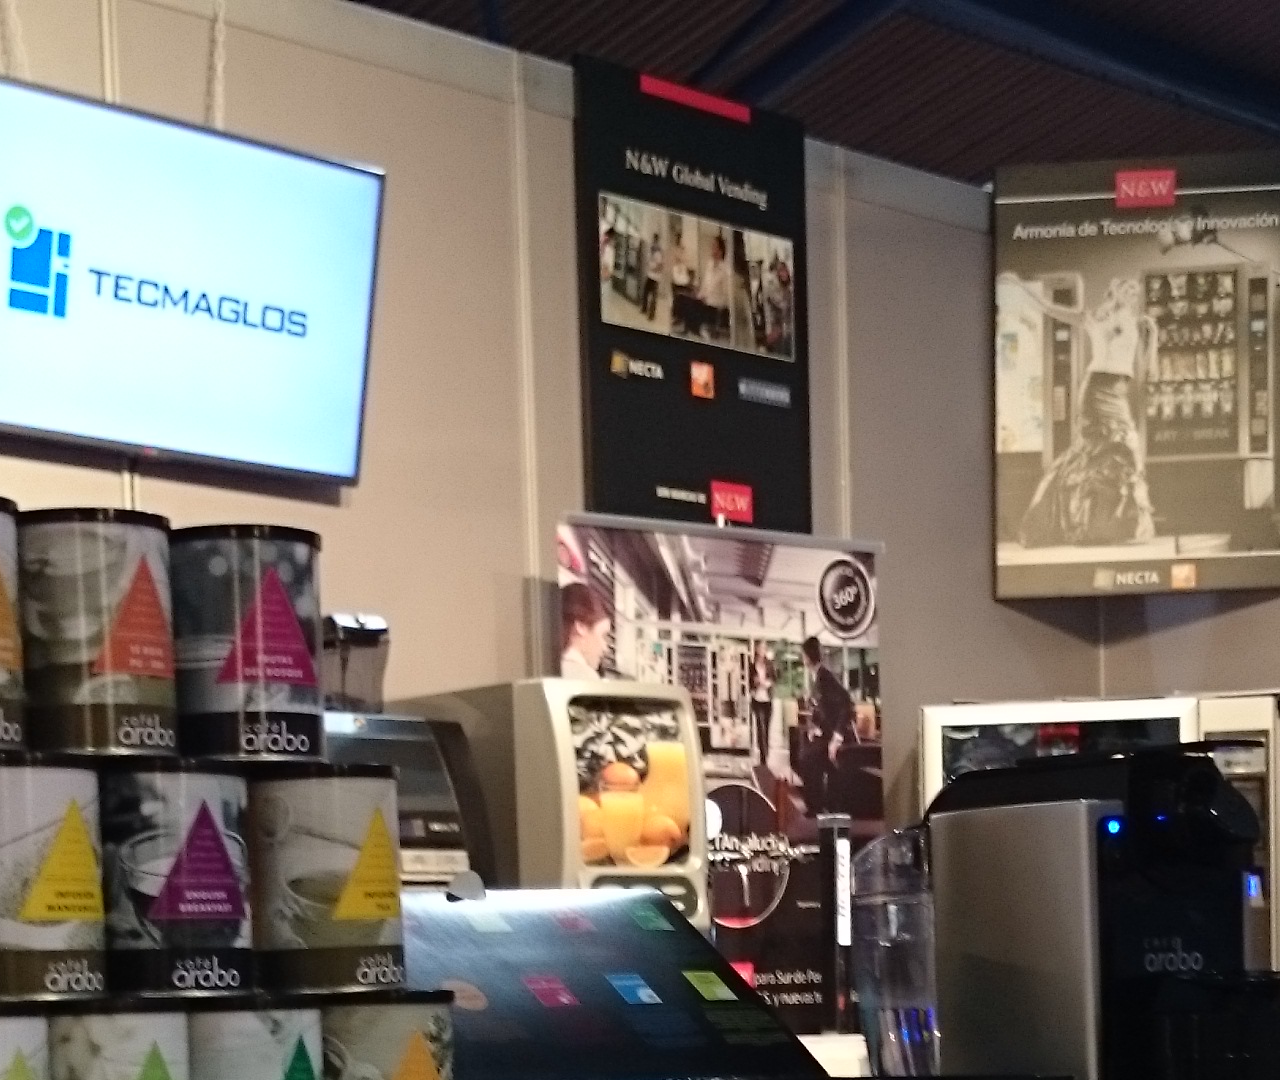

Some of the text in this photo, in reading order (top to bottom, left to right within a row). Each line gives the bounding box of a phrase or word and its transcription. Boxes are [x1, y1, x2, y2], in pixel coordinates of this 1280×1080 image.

[624, 147, 768, 211] N&W Global Vending
[1121, 179, 1171, 198] N&W
[1012, 221, 1075, 241] Armonía
[1078, 221, 1098, 237] de
[1196, 210, 1280, 231] Innovación
[88, 267, 308, 338] TECMAGLOS
[628, 360, 665, 380] NECTA
[1116, 571, 1159, 586] NECTA
[117, 713, 176, 748] arabo
[242, 720, 310, 753] arabo
[44, 958, 104, 992] arabo
[171, 954, 240, 988] arabo
